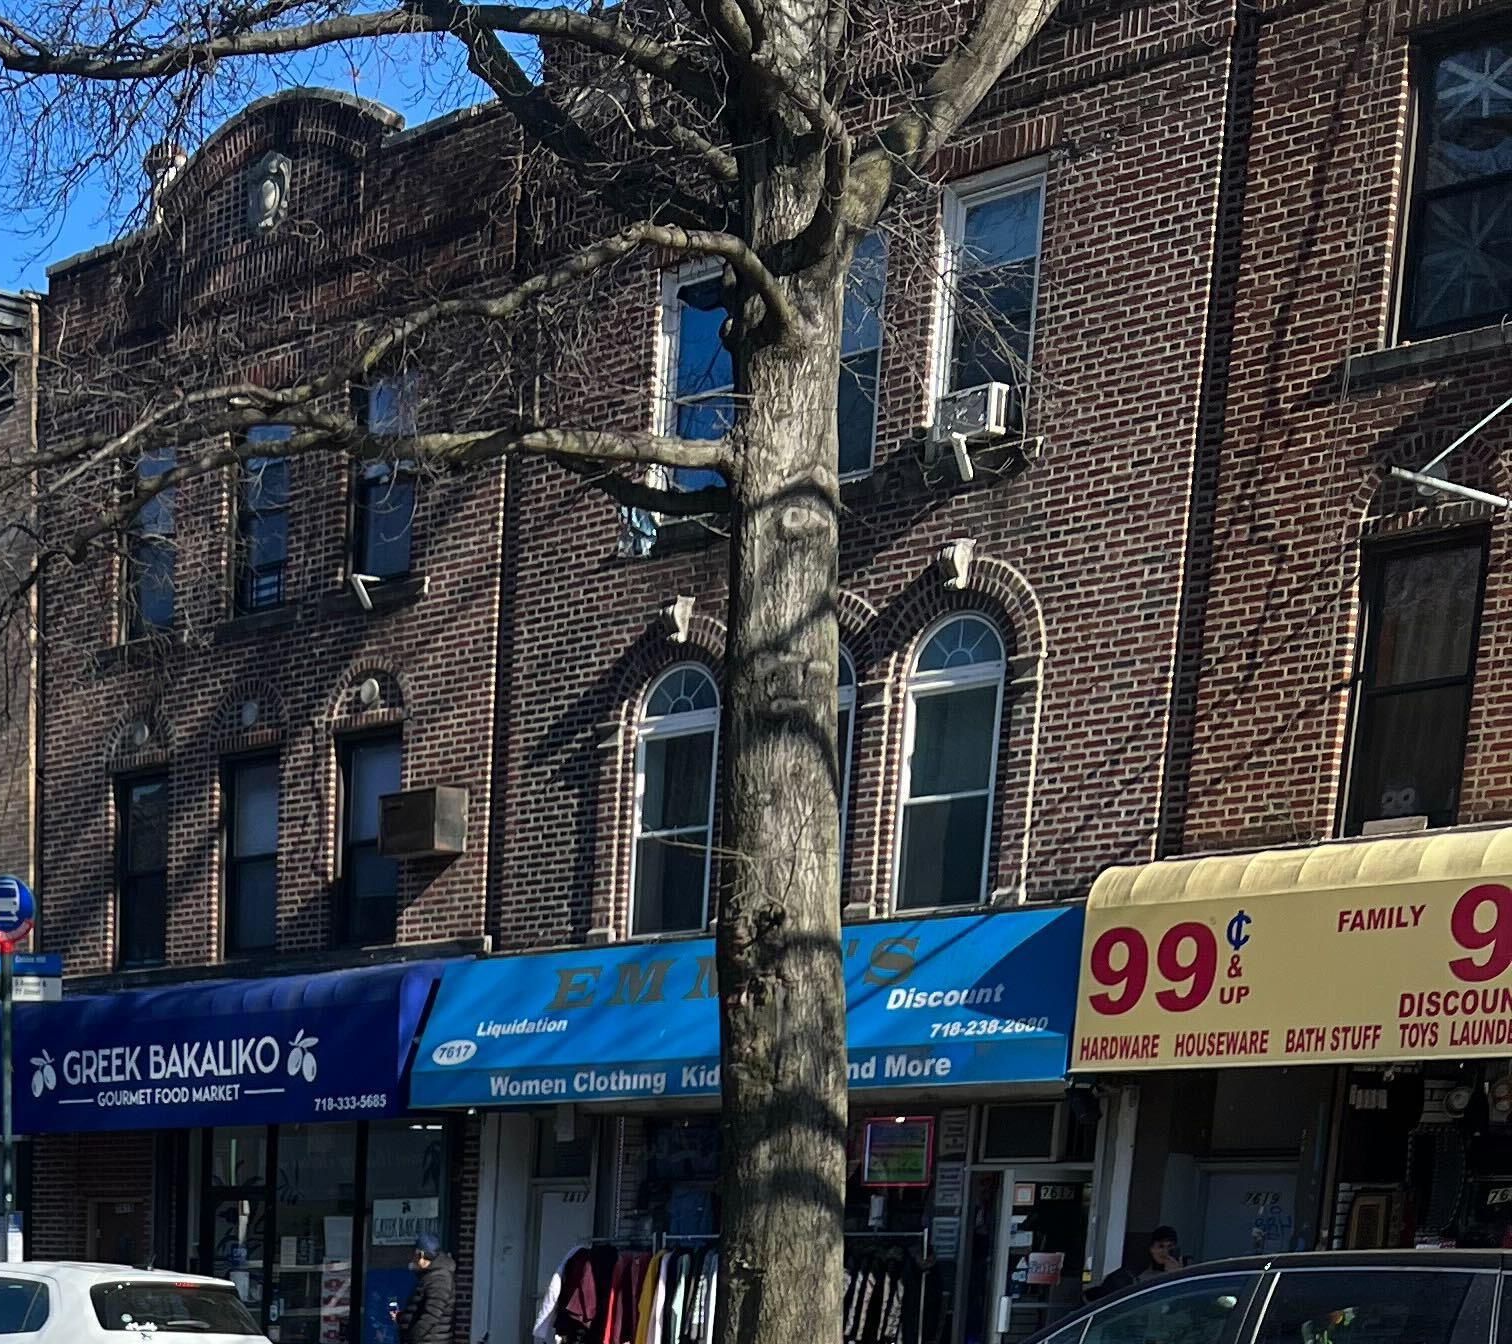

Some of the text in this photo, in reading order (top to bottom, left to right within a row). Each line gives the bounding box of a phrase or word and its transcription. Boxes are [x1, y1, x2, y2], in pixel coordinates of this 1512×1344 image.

[1338, 904, 1426, 932] FAMILY
[1227, 954, 1243, 979] &
[886, 983, 1006, 1010] Discount
[1219, 986, 1250, 1004] UP
[476, 1017, 568, 1038] Liquidation
[437, 1045, 472, 1059] 7617
[1080, 1034, 1160, 1061] HARDWARE
[1174, 1030, 1269, 1057] HOUSEWARE
[1285, 1027, 1327, 1053] BATH
[1330, 1025, 1382, 1052] STUFF
[1399, 1022, 1439, 1048] TOYS
[63, 1036, 280, 1085] GREEK BAKALIKO
[490, 1075, 566, 1097] Women
[573, 1070, 666, 1095] Clothing
[884, 1055, 952, 1078] More
[97, 1084, 241, 1106] GOURMET FOOD MARKET
[314, 1094, 387, 1111] 718-333-5685
